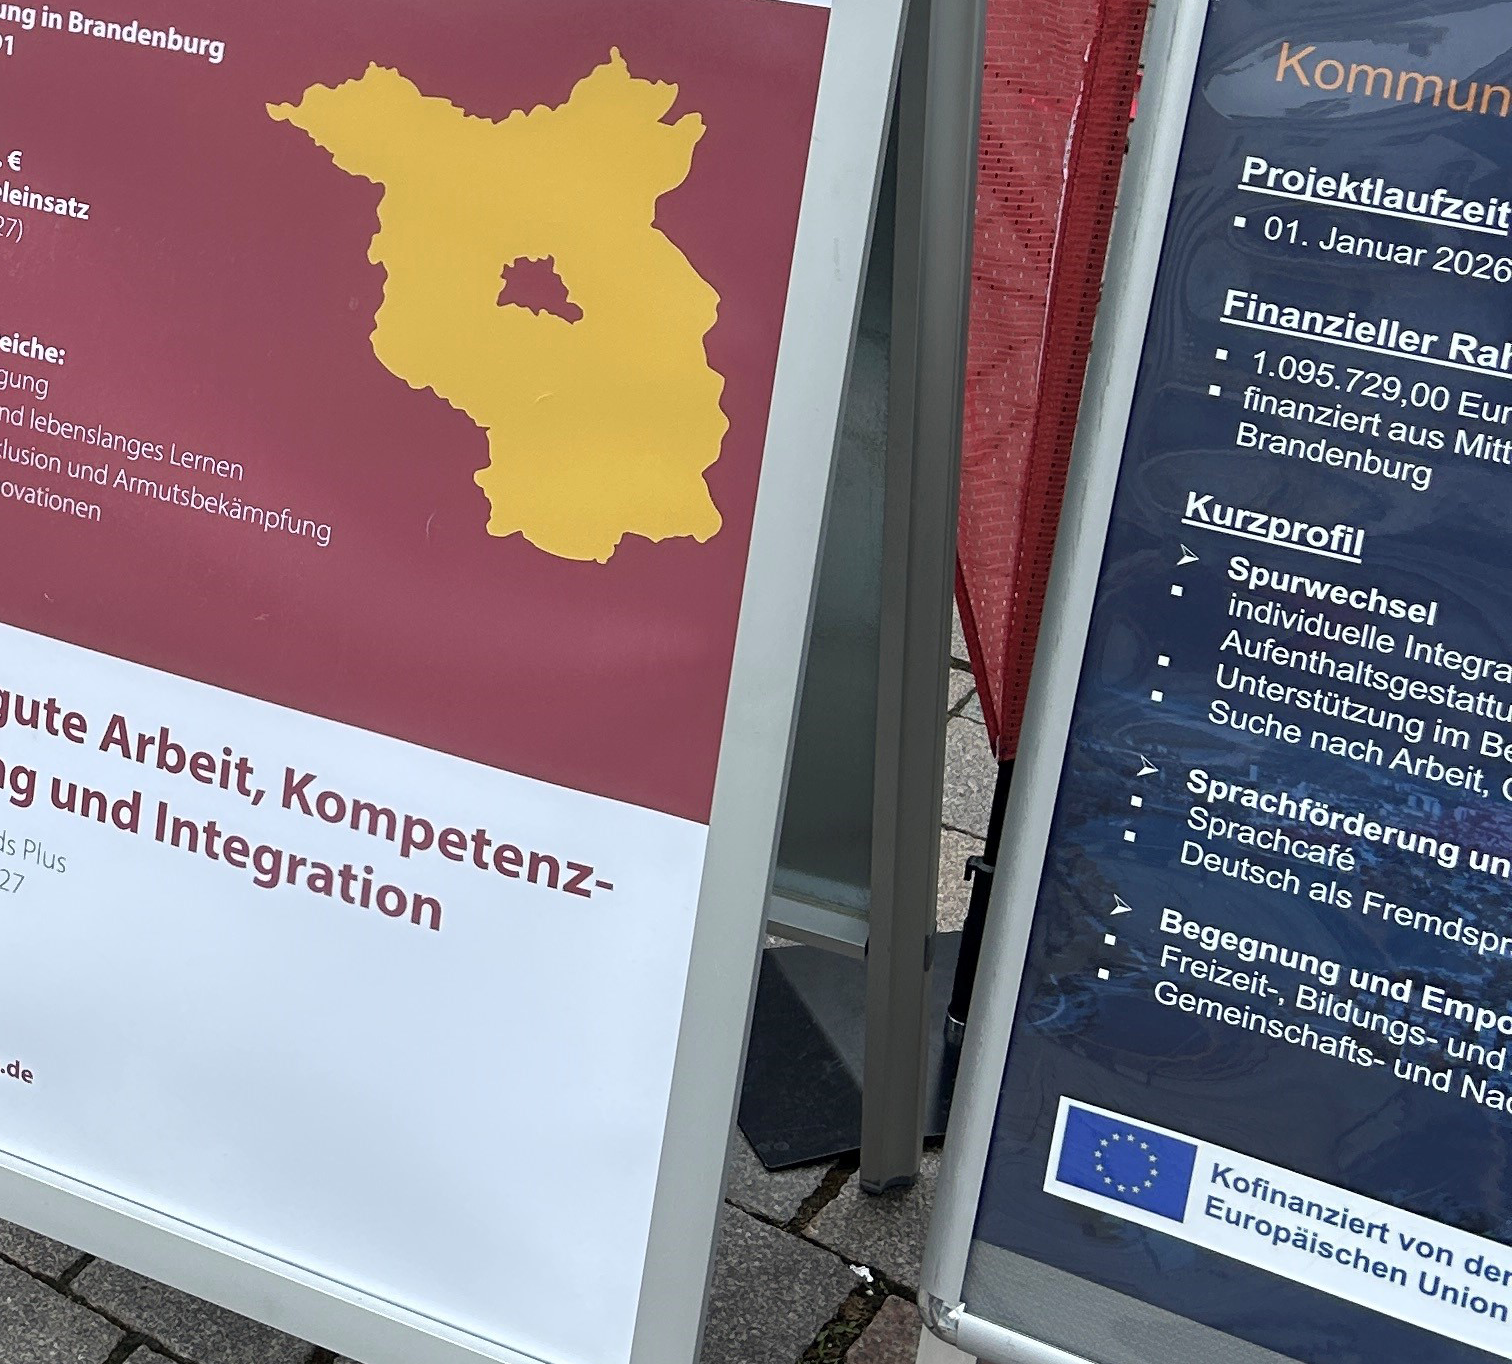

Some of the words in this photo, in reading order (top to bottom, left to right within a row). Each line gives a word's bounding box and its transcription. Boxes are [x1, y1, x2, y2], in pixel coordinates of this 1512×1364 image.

[41, 6, 62, 29] in
[69, 11, 225, 63] Brandenburg
[8, 151, 22, 171] €
[1242, 156, 1511, 228] Projektlaufzeit
[1265, 216, 1307, 246] 01.
[1319, 227, 1427, 266] Januar
[1433, 247, 1512, 282] 2026
[1224, 289, 1438, 354] Finanzieller
[1254, 351, 1449, 411] 1.095.729,00
[30, 408, 163, 460] lebenslanges
[170, 443, 243, 481] Lernen
[1244, 386, 1382, 436] finanziert
[1388, 423, 1444, 449] aus
[1237, 422, 1432, 491] Brandenburg
[68, 462, 108, 485] und
[113, 469, 331, 546] Armutsbekämpfung
[1186, 492, 1364, 556] Kurzprofil
[1228, 557, 1437, 625] Spurwechsel
[1229, 593, 1394, 653] individuelle
[1217, 664, 1424, 743] Unterstützung
[1209, 700, 1301, 743] Suche
[1310, 731, 1383, 765] nach
[1389, 748, 1488, 797] Arbeit,
[99, 714, 265, 805] Arbeit,
[282, 767, 613, 898] Kompetenz-
[1187, 769, 1459, 868] Sprachförderung
[1188, 807, 1355, 871] Sprachcafé
[24, 839, 66, 873] Plus
[51, 777, 141, 834] und
[155, 801, 441, 931] Integration
[1181, 841, 1299, 894] Deutsch
[1309, 881, 1352, 908] als
[1160, 908, 1340, 985] Begegnung
[1350, 969, 1412, 1003] und
[1155, 981, 1385, 1066] Gemeinschafts-
[1394, 1059, 1452, 1092] und
[1161, 945, 1284, 1005] Freizeit-,
[1296, 985, 1438, 1045] Bildungs-
[1447, 1037, 1506, 1071] und
[1211, 1163, 1389, 1244] Kofinanziert
[1400, 1233, 1453, 1267] von
[1205, 1195, 1407, 1286] Europäischen
[1419, 1271, 1507, 1322] Union
